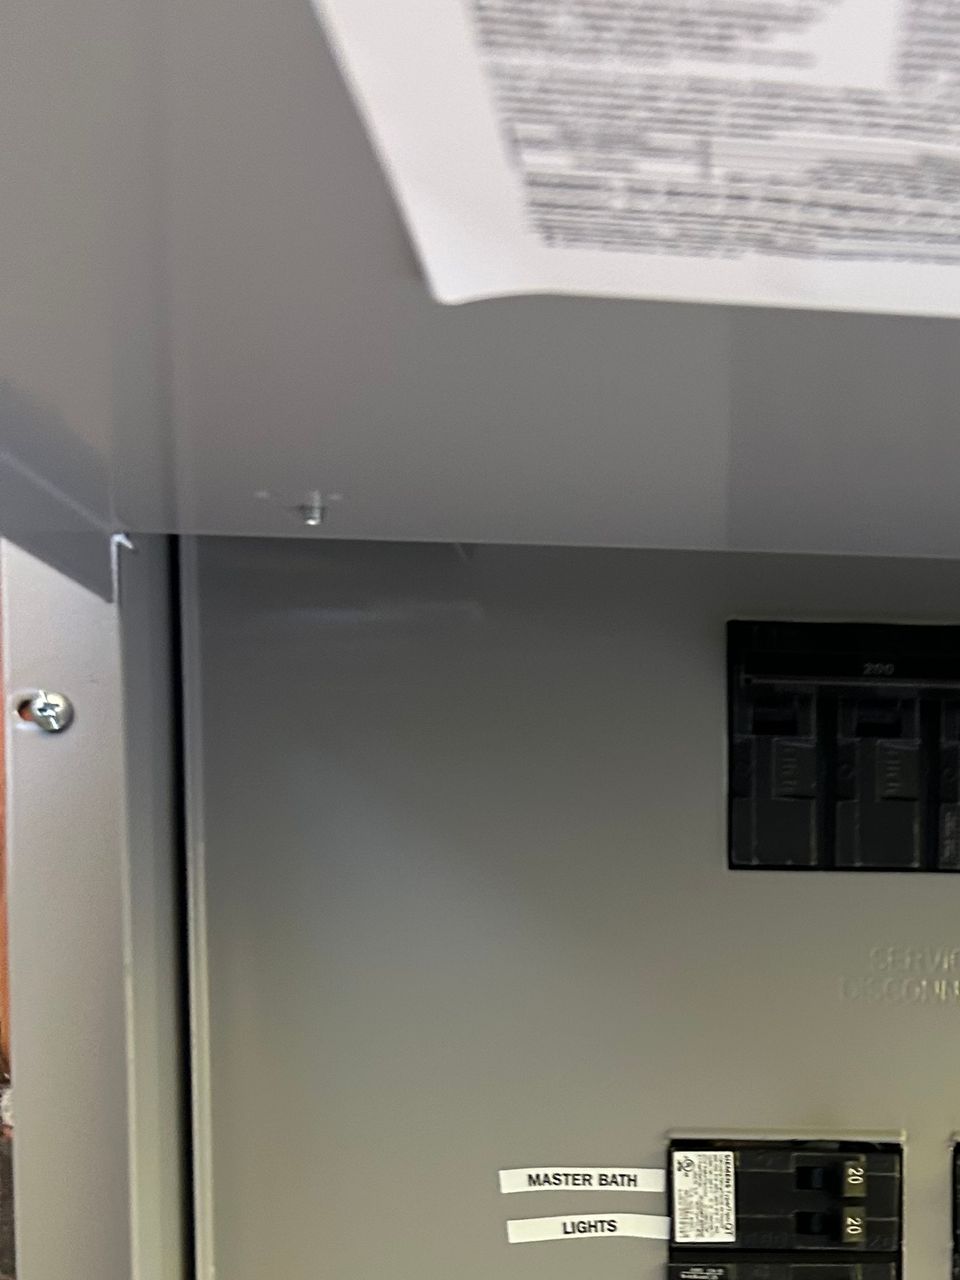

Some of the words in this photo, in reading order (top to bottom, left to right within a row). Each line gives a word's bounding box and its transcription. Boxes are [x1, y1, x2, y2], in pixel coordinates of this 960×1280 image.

[528, 1174, 592, 1188] MASTER
[599, 1174, 638, 1187] BATH
[847, 1167, 864, 1185] 20
[563, 1220, 617, 1235] LIGHTS
[846, 1217, 862, 1234] 20
